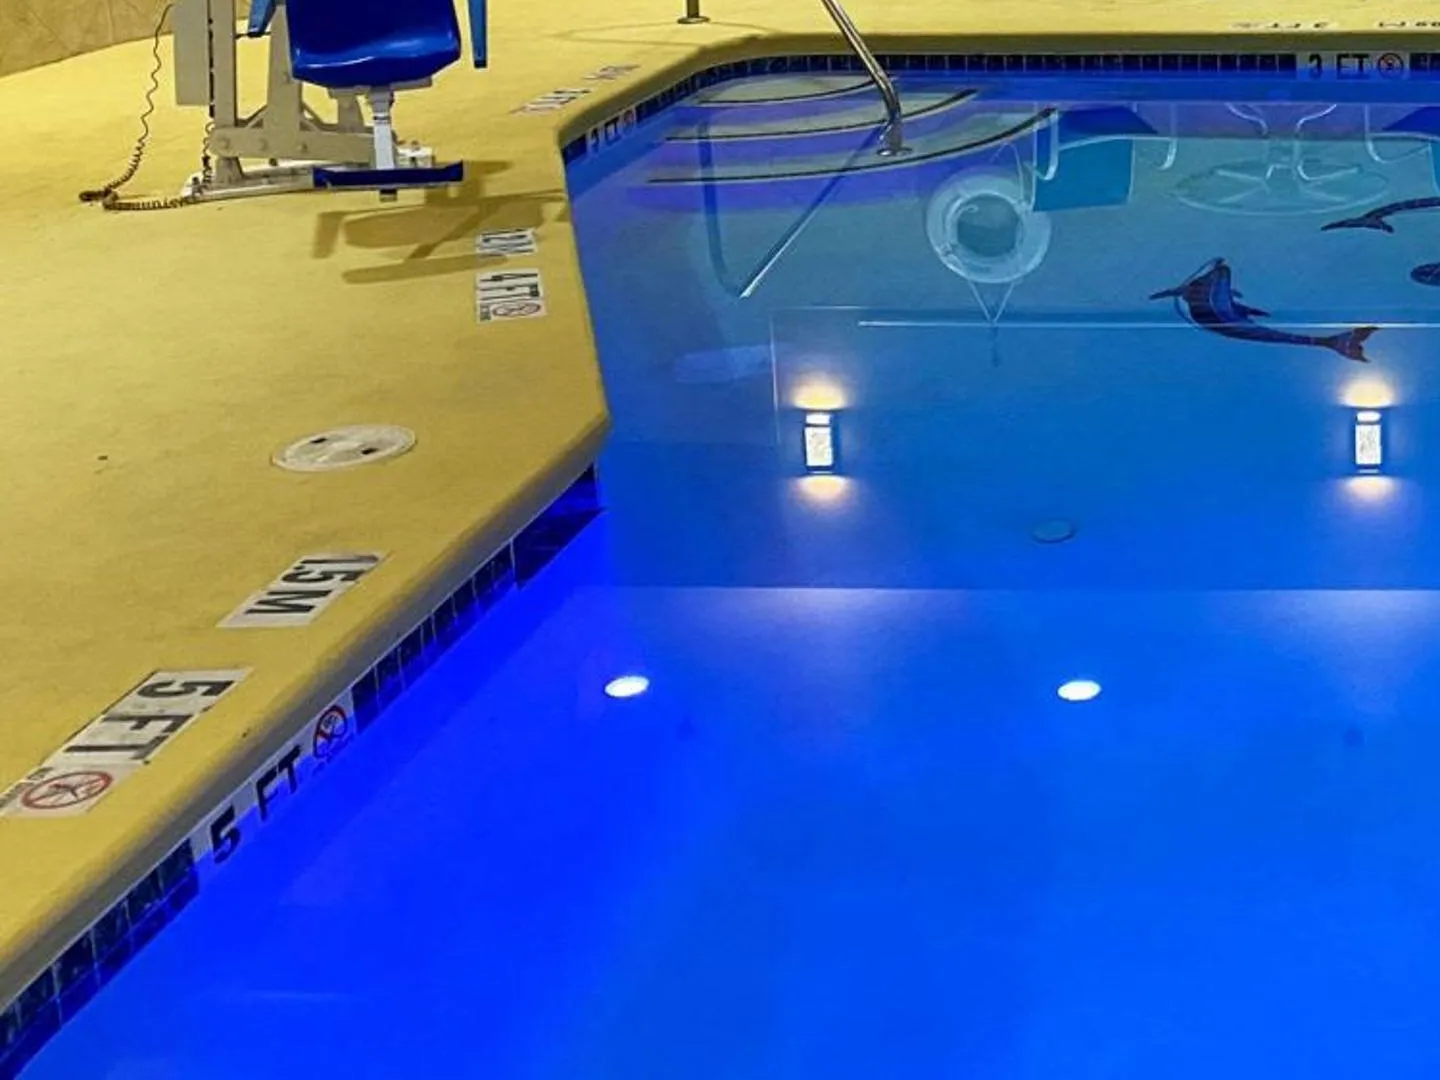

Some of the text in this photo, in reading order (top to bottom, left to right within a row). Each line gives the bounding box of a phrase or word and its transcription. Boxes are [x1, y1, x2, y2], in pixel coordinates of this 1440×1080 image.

[62, 680, 236, 761] 5 FT
[210, 744, 301, 864] 5 FT
